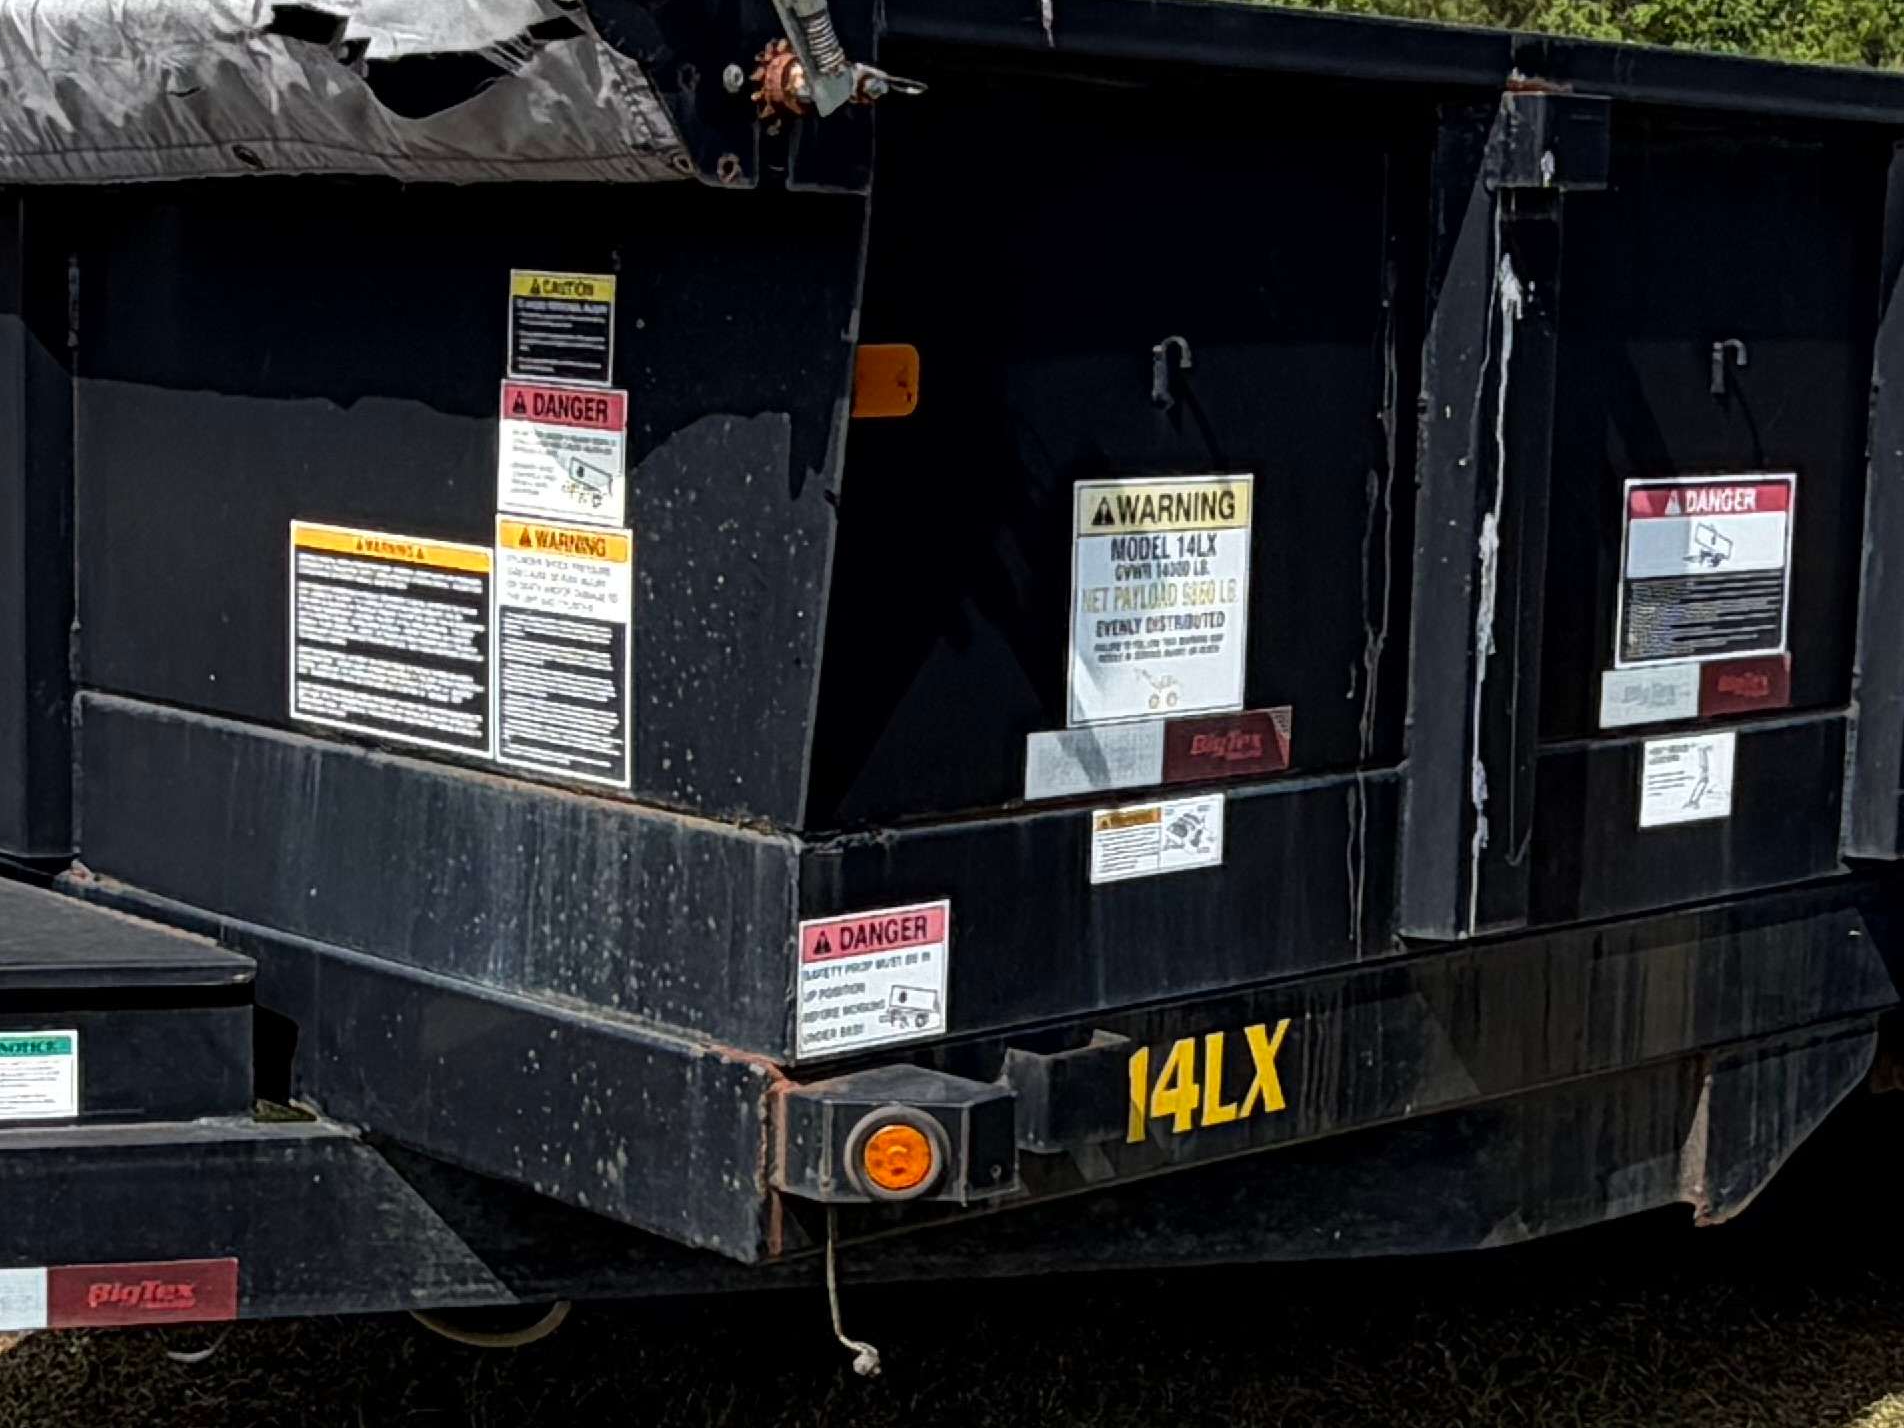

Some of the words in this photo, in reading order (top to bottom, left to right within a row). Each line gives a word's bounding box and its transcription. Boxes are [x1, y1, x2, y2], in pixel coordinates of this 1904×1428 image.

[533, 392, 609, 423] DANGER
[1116, 489, 1236, 526] WARNING
[1685, 487, 1757, 513] DANGER
[534, 529, 607, 558] WARNING
[1110, 535, 1171, 562] MODEL
[1176, 532, 1218, 558] 14LX
[1081, 586, 1110, 614] NET
[1114, 582, 1178, 612] PAYLOAD
[1096, 618, 1142, 638] EVENLY
[1146, 610, 1226, 634] DISTRIBUTED
[839, 915, 927, 951] DANGER
[1126, 1018, 1292, 1144] 14LX
[87, 1279, 195, 1308] BigTex
